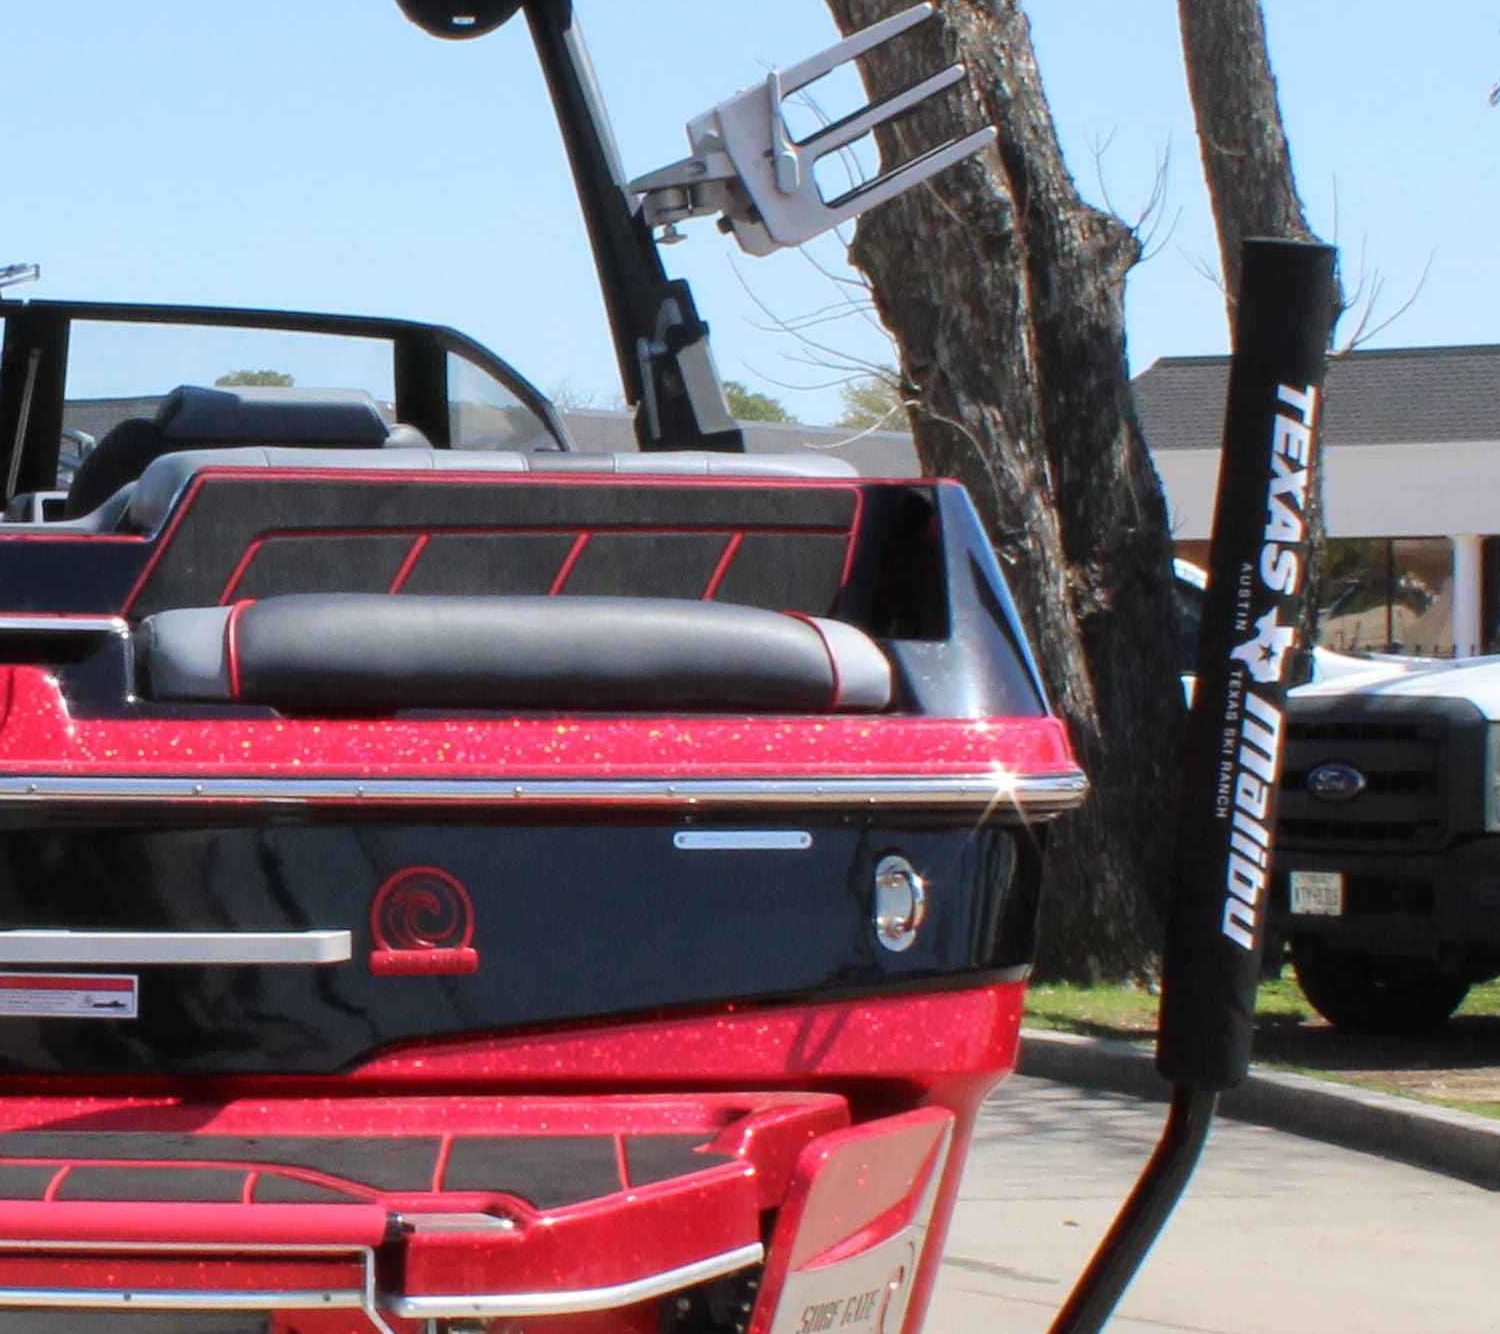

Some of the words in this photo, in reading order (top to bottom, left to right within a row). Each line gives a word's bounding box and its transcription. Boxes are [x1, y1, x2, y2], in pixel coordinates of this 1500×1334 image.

[1259, 383, 1317, 596] TEXAS
[1235, 562, 1254, 632] AUSTIN
[1223, 669, 1242, 720] TEXAS
[1222, 727, 1236, 755] SKI
[1215, 761, 1233, 819] RANCH
